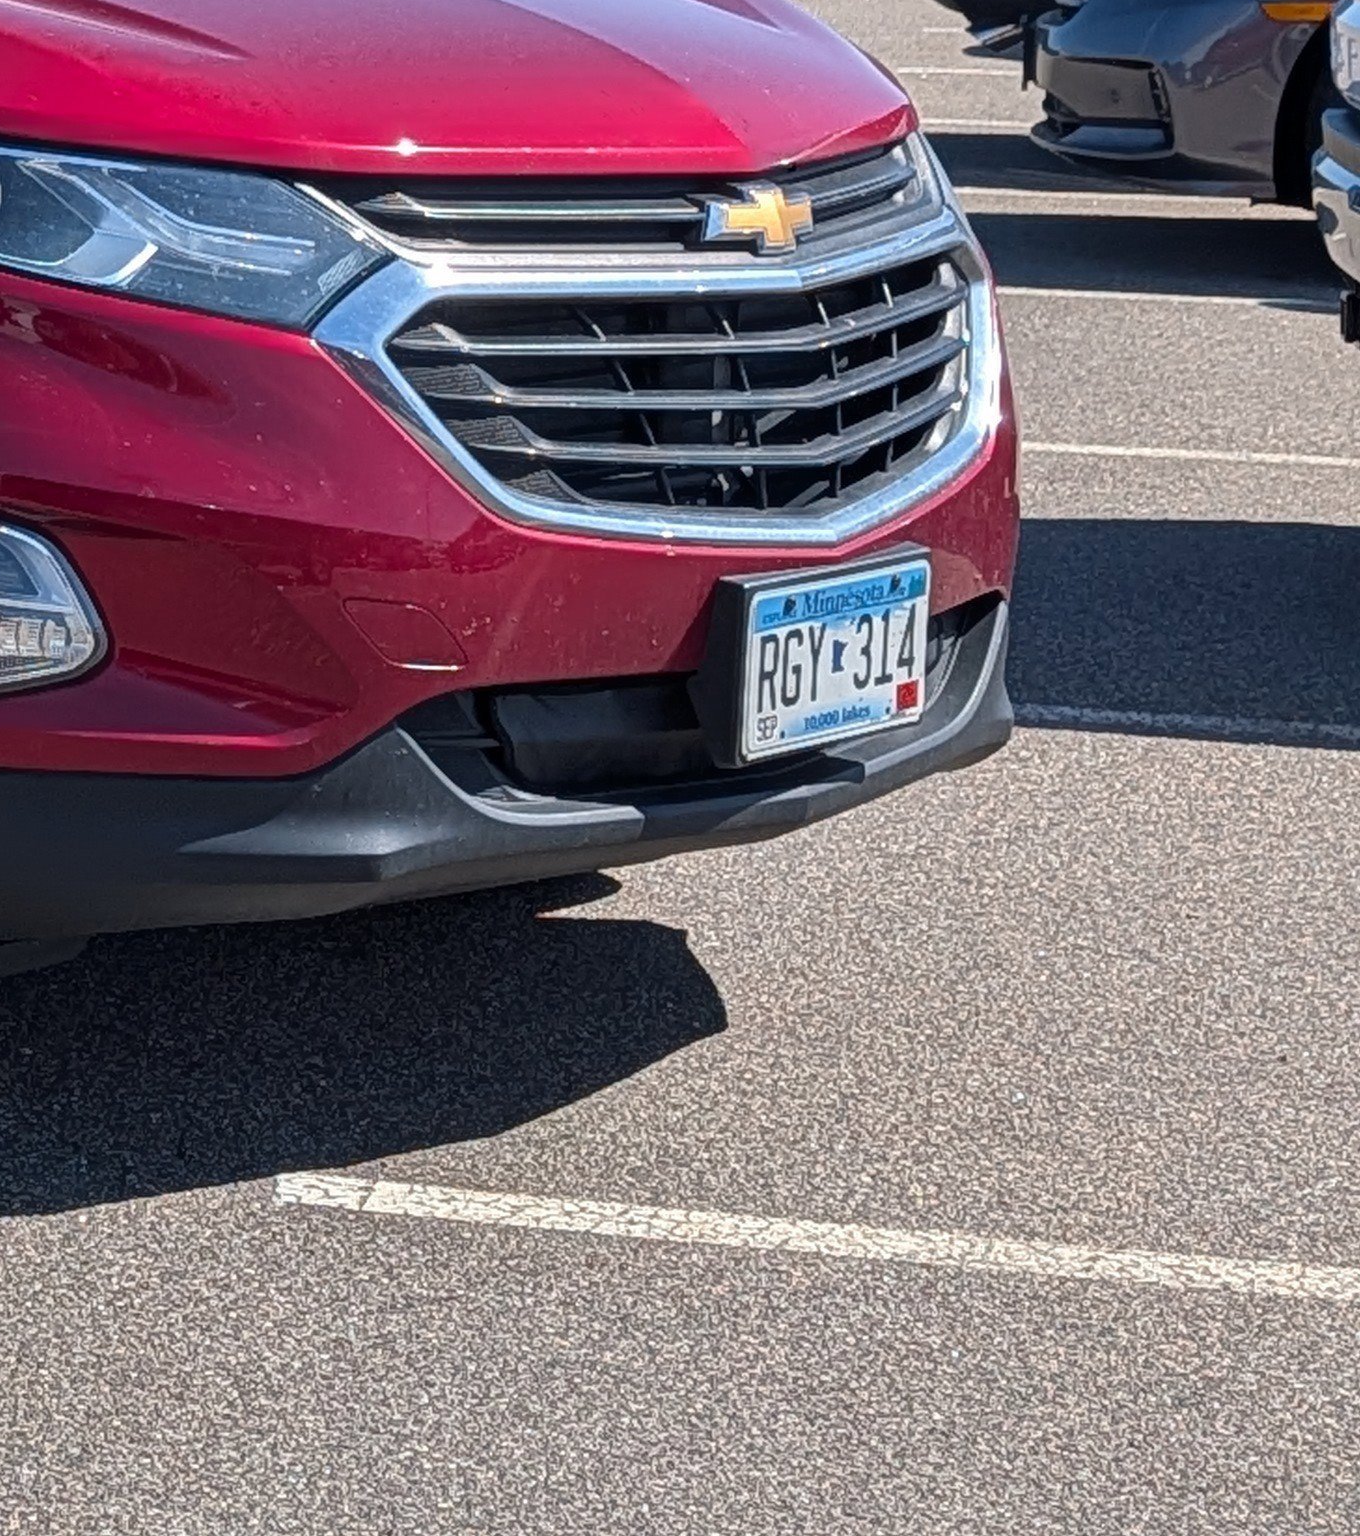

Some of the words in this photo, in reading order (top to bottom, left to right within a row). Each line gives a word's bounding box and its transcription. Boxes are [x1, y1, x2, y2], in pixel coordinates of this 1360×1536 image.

[801, 583, 885, 616] Minnesota
[756, 622, 828, 713] RGY
[852, 604, 918, 690] 314
